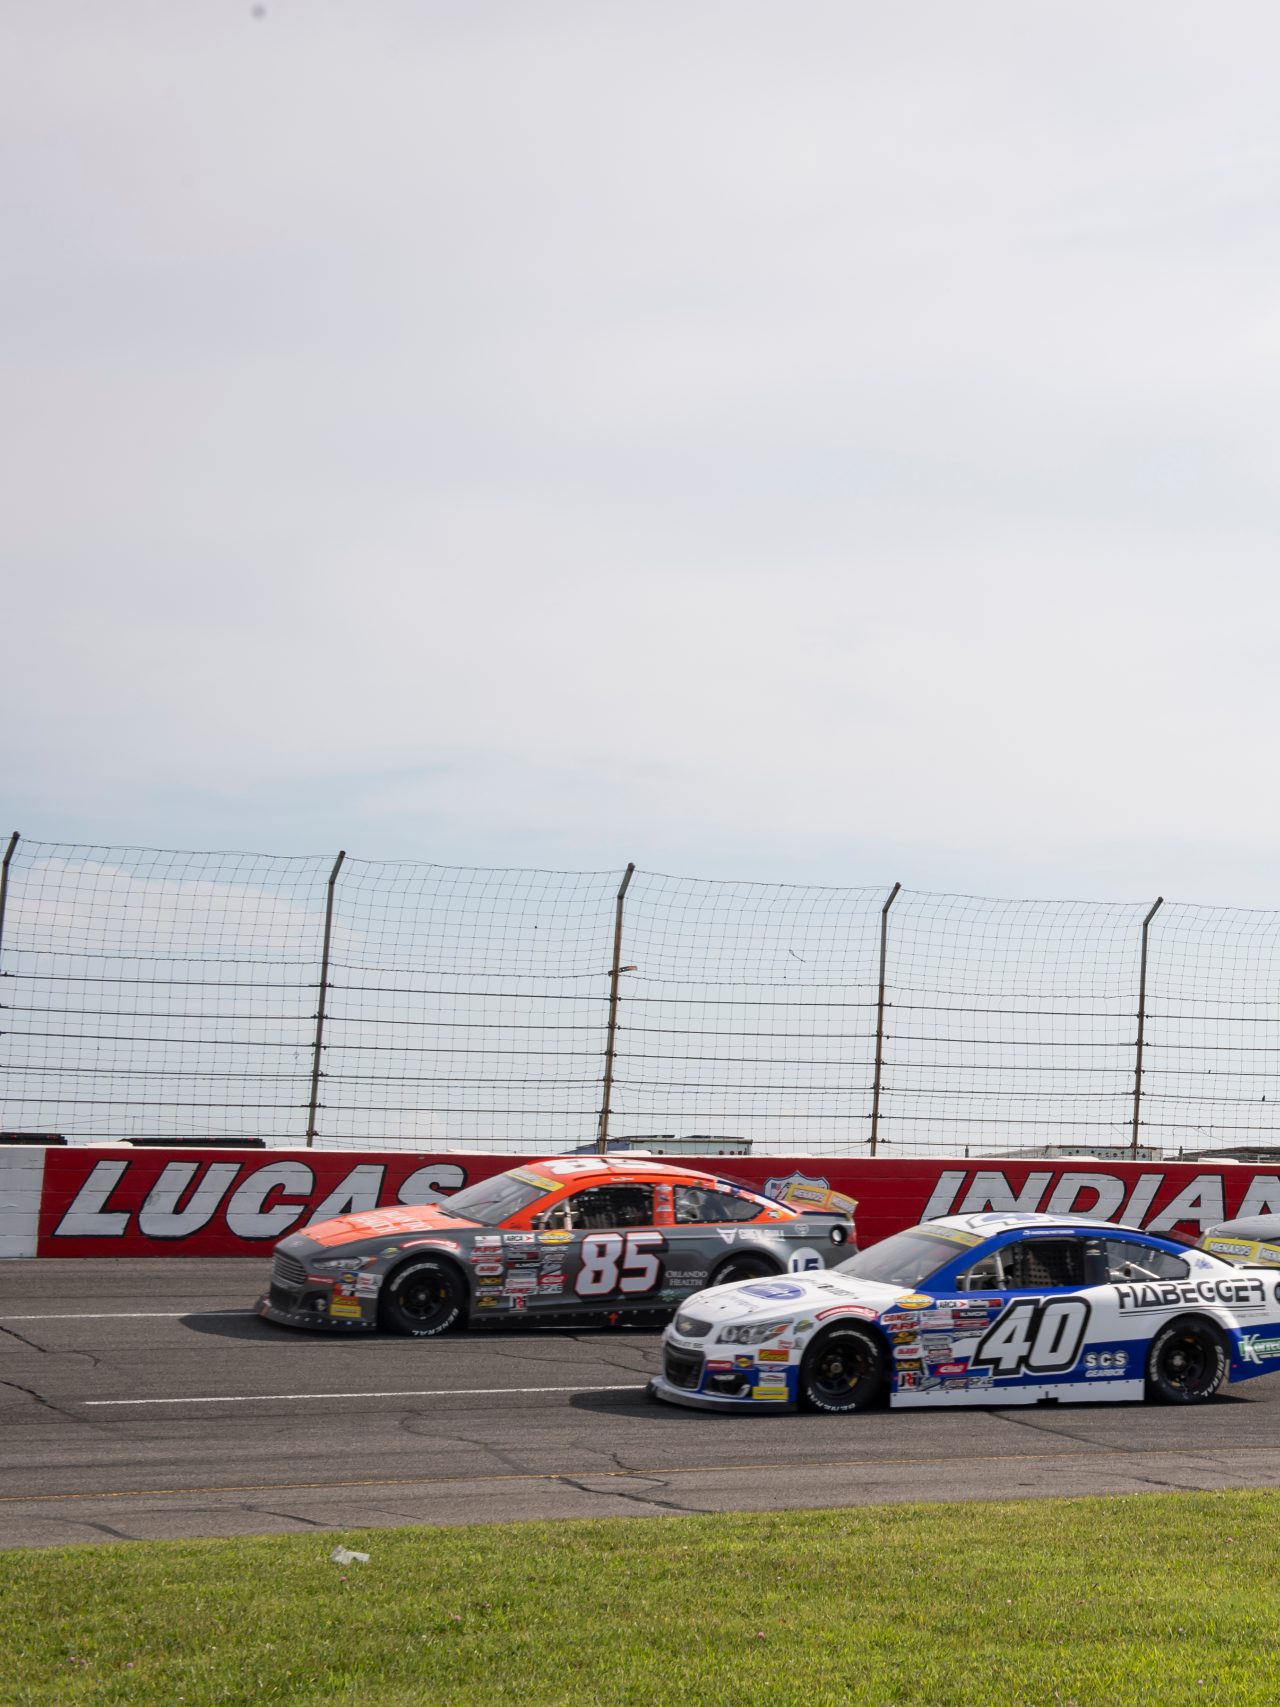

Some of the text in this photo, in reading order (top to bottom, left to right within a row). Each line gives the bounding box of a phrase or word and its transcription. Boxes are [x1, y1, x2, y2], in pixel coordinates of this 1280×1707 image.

[52, 1160, 467, 1241] LUCAS
[575, 1231, 663, 1296] 85
[1210, 1241, 1251, 1257] MENARDS
[664, 1270, 708, 1279] ORLANDO
[669, 1277, 703, 1287] HEALTH
[1114, 1277, 1266, 1309] HABEGGER
[412, 1307, 460, 1336] GENERAL
[973, 1297, 1091, 1377] 40
[1084, 1350, 1128, 1368] SCS
[1200, 1345, 1225, 1397] GENERAL
[806, 1387, 856, 1412] GENERAL
